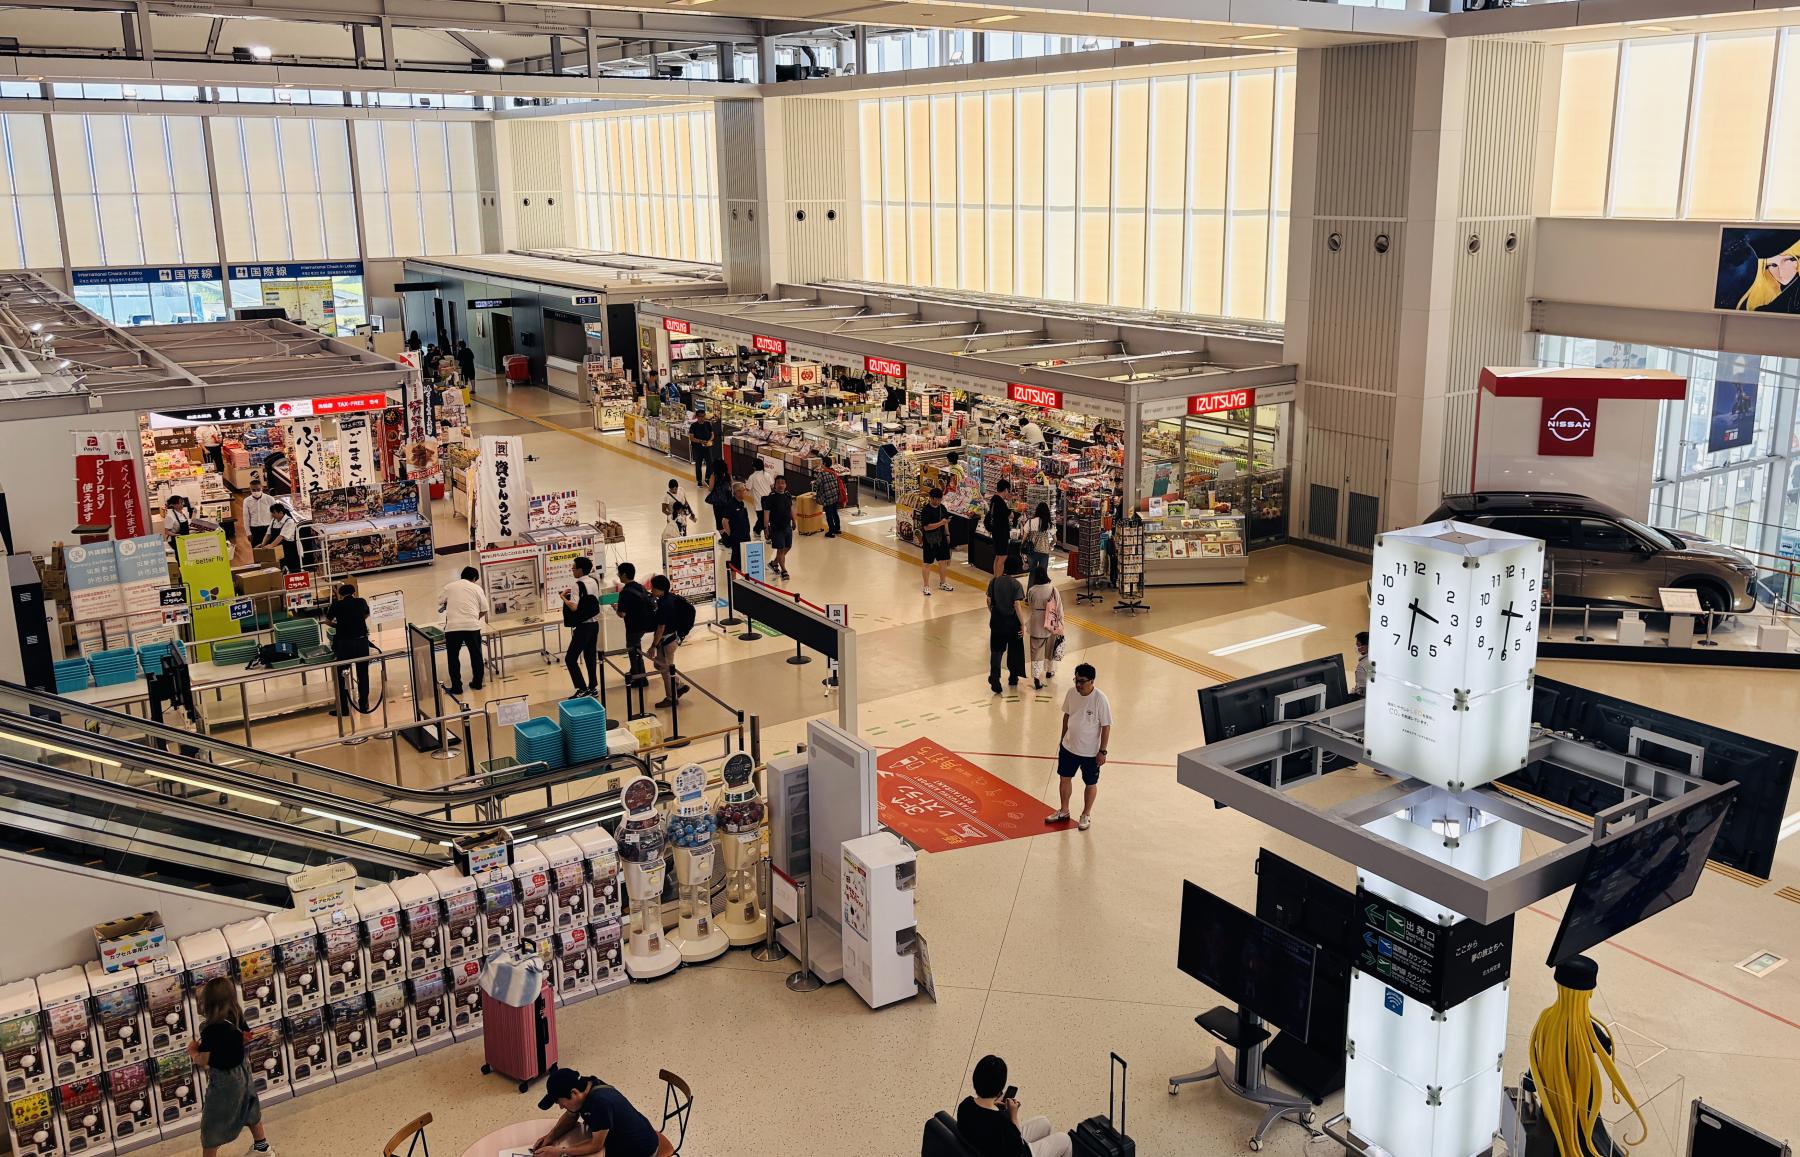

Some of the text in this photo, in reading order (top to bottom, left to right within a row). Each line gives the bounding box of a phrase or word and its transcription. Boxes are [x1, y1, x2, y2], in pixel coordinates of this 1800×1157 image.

[174, 268, 213, 280] 国際線
[250, 266, 288, 277] 国際線
[337, 400, 364, 408] TAX-FREE
[1547, 420, 1591, 428] NISSAN
[96, 459, 106, 510] PayPay
[82, 482, 95, 522] 使えます
[495, 460, 512, 537] 資さんうどん
[195, 555, 224, 565] better fly
[1396, 562, 1407, 576] 11
[1413, 561, 1426, 575] 12
[1505, 565, 1515, 578] 12
[1521, 568, 1525, 579] 1
[1382, 574, 1394, 587] 10
[1436, 572, 1441, 585] 1
[1492, 575, 1501, 588] 11
[287, 581, 308, 589] こちらへ
[1528, 579, 1535, 592] 2
[1377, 594, 1385, 605] 9
[1446, 591, 1455, 604] 2
[1480, 592, 1490, 605] 10
[1530, 600, 1537, 611] 3
[231, 610, 252, 619] こちらへ
[1380, 616, 1389, 628] 8
[1450, 615, 1459, 627] 3
[1476, 616, 1482, 628] 9
[1526, 621, 1532, 632] 4
[1392, 634, 1401, 646] 7
[1443, 634, 1452, 646] 4
[1477, 636, 1484, 648] 8
[1514, 639, 1521, 651] 5
[1410, 645, 1418, 657] 6
[1429, 645, 1437, 657] 5
[1488, 648, 1494, 660] 7
[1501, 649, 1507, 661] 6
[933, 780, 976, 805] RESTAURANT
[897, 785, 956, 818] レストラン
[899, 802, 925, 816] 3F
[1406, 920, 1435, 942] 出発口
[109, 941, 161, 960] カプセル専用ゴミ箱
[1455, 939, 1478, 957] ここから
[1408, 952, 1433, 968] カウンター
[1407, 971, 1432, 987] カウンター
